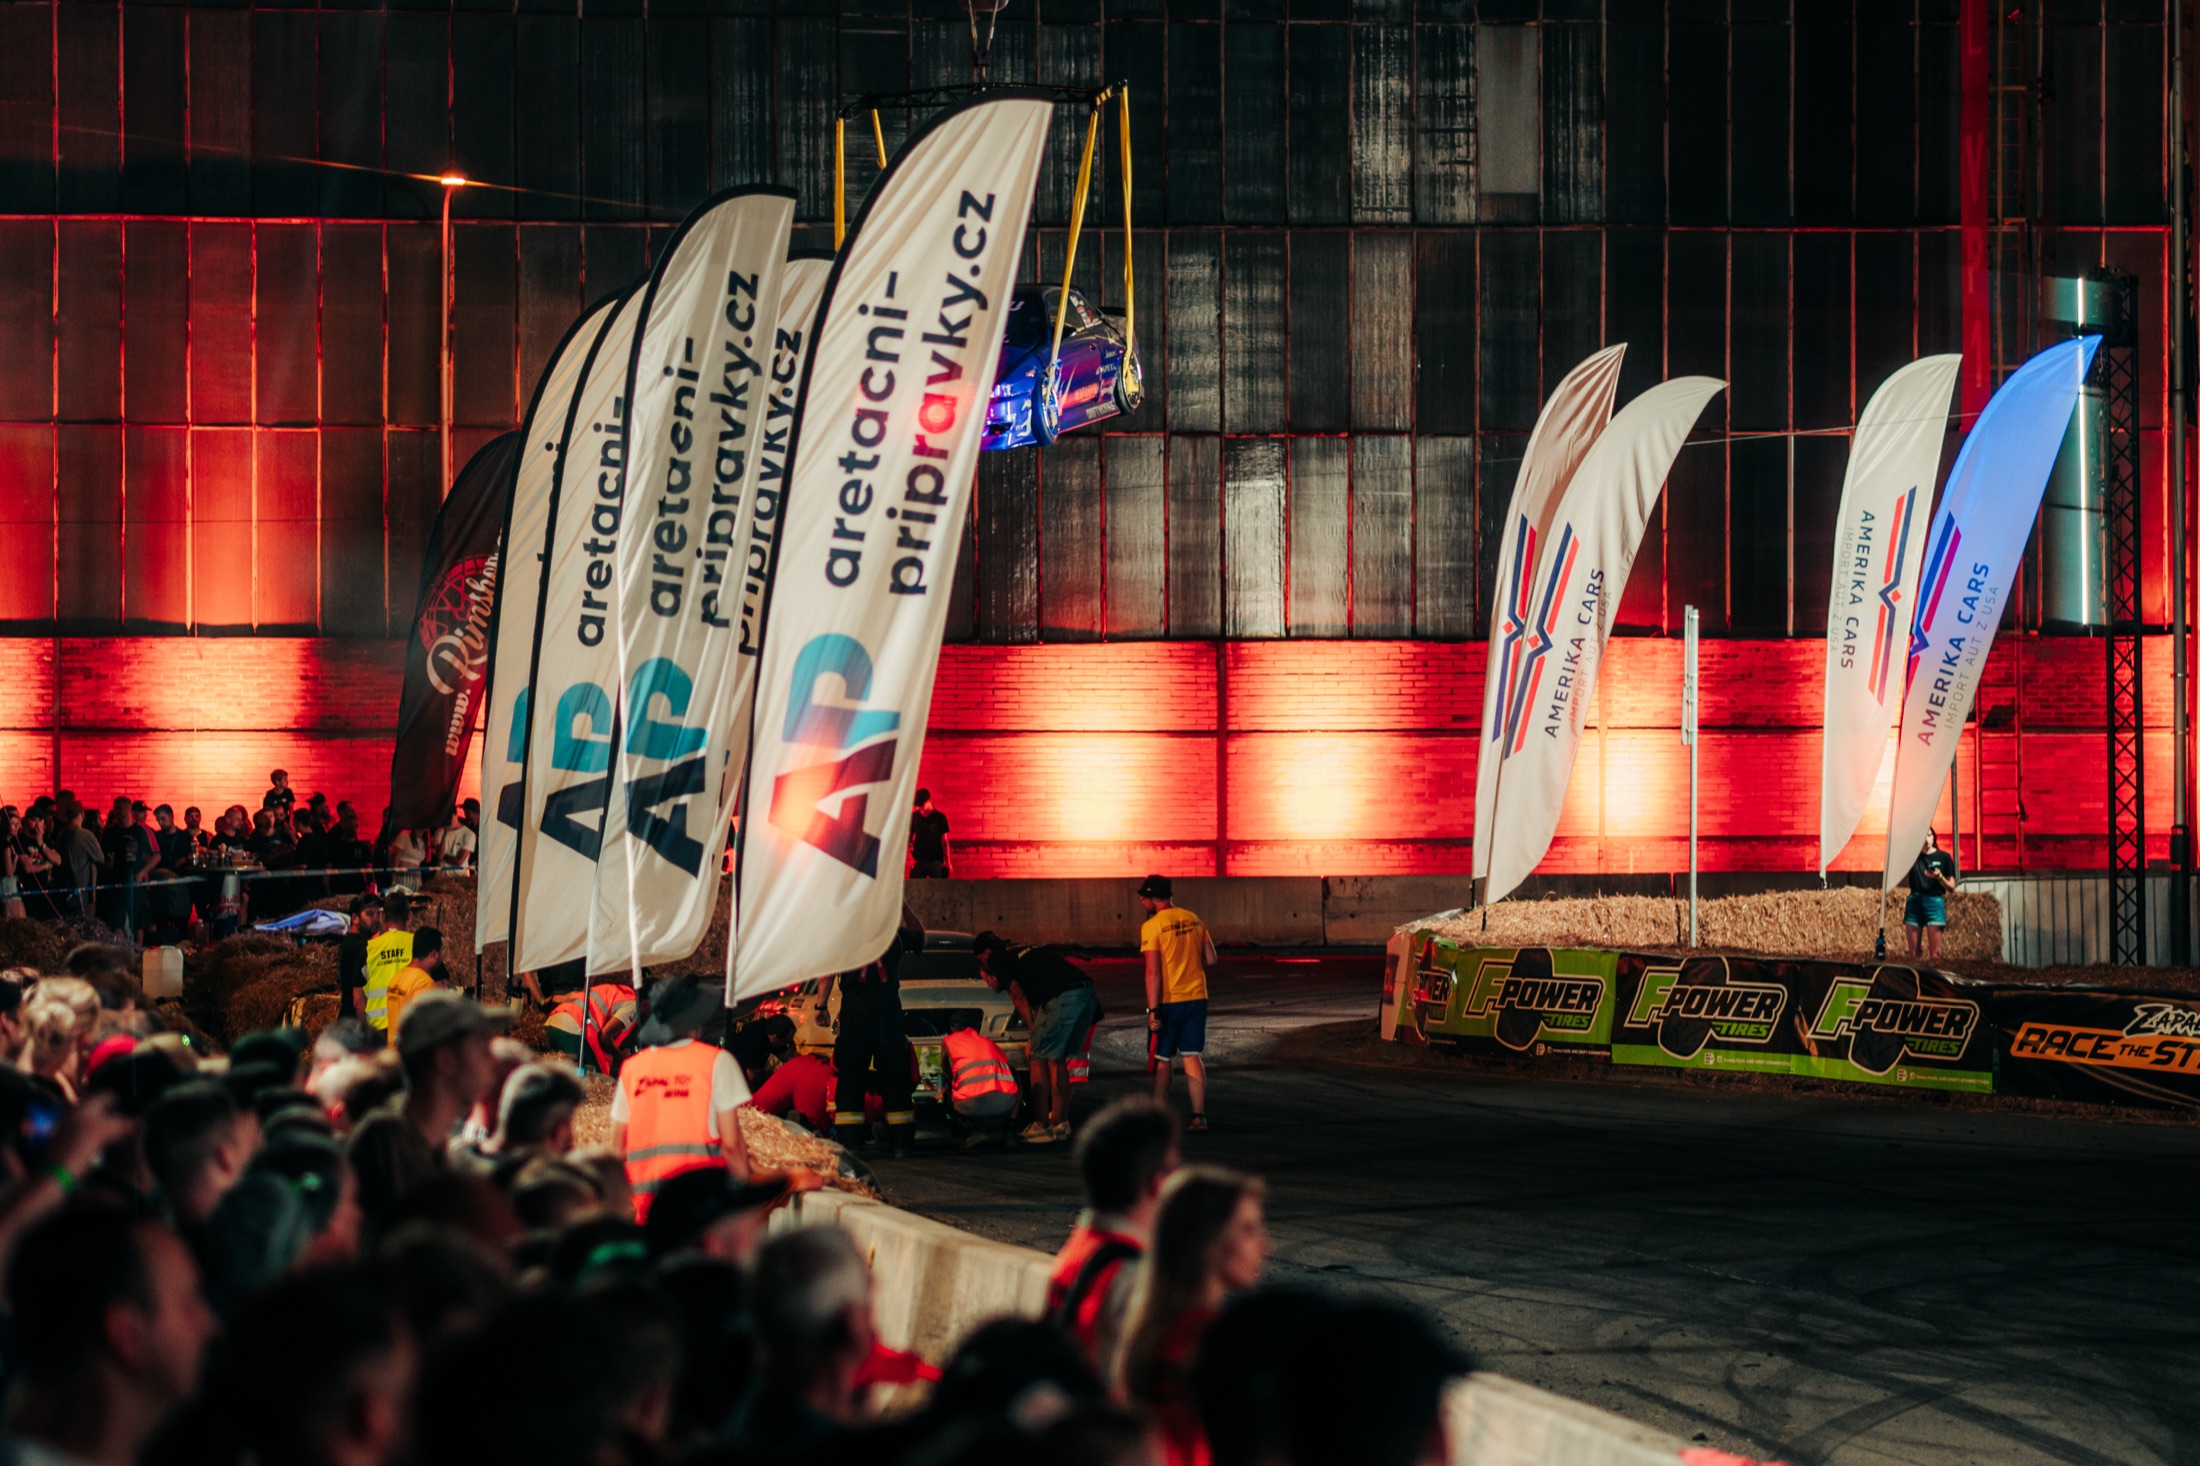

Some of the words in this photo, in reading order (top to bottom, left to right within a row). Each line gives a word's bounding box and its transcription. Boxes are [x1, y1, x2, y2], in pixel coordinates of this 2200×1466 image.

[825, 271, 908, 588] aretacni-
[886, 190, 996, 595] pripravky.cz
[650, 338, 701, 618] aretacni-
[694, 271, 762, 628] pripravky.cz
[1835, 583, 1847, 608] AUT
[1839, 526, 1855, 577] IMPORT
[1848, 509, 1876, 606] AMERIKA
[1544, 636, 1586, 739] AMERIKA
[1577, 568, 1605, 626] CARS
[1568, 670, 1590, 723] IMPORT
[1599, 591, 1613, 618] USA
[1829, 627, 1840, 652] USA
[1840, 616, 1860, 669] CARS
[1917, 637, 1966, 747] AMERIKA
[1957, 562, 1990, 624] CARS
[1944, 673, 1970, 730] IMPORT
[1965, 638, 1982, 667] AUT
[1976, 621, 1987, 632] Z
[1982, 586, 1999, 617] USA
[768, 633, 901, 880] AP
[380, 948, 405, 960] STAFF
[1543, 1012, 1590, 1028] TIRES
[1712, 1021, 1770, 1038] TIRES
[1905, 1036, 1962, 1055] TIRES
[2016, 1027, 2125, 1061] RACE
[2119, 1043, 2153, 1058] THE
[2148, 1040, 2200, 1071] ST
